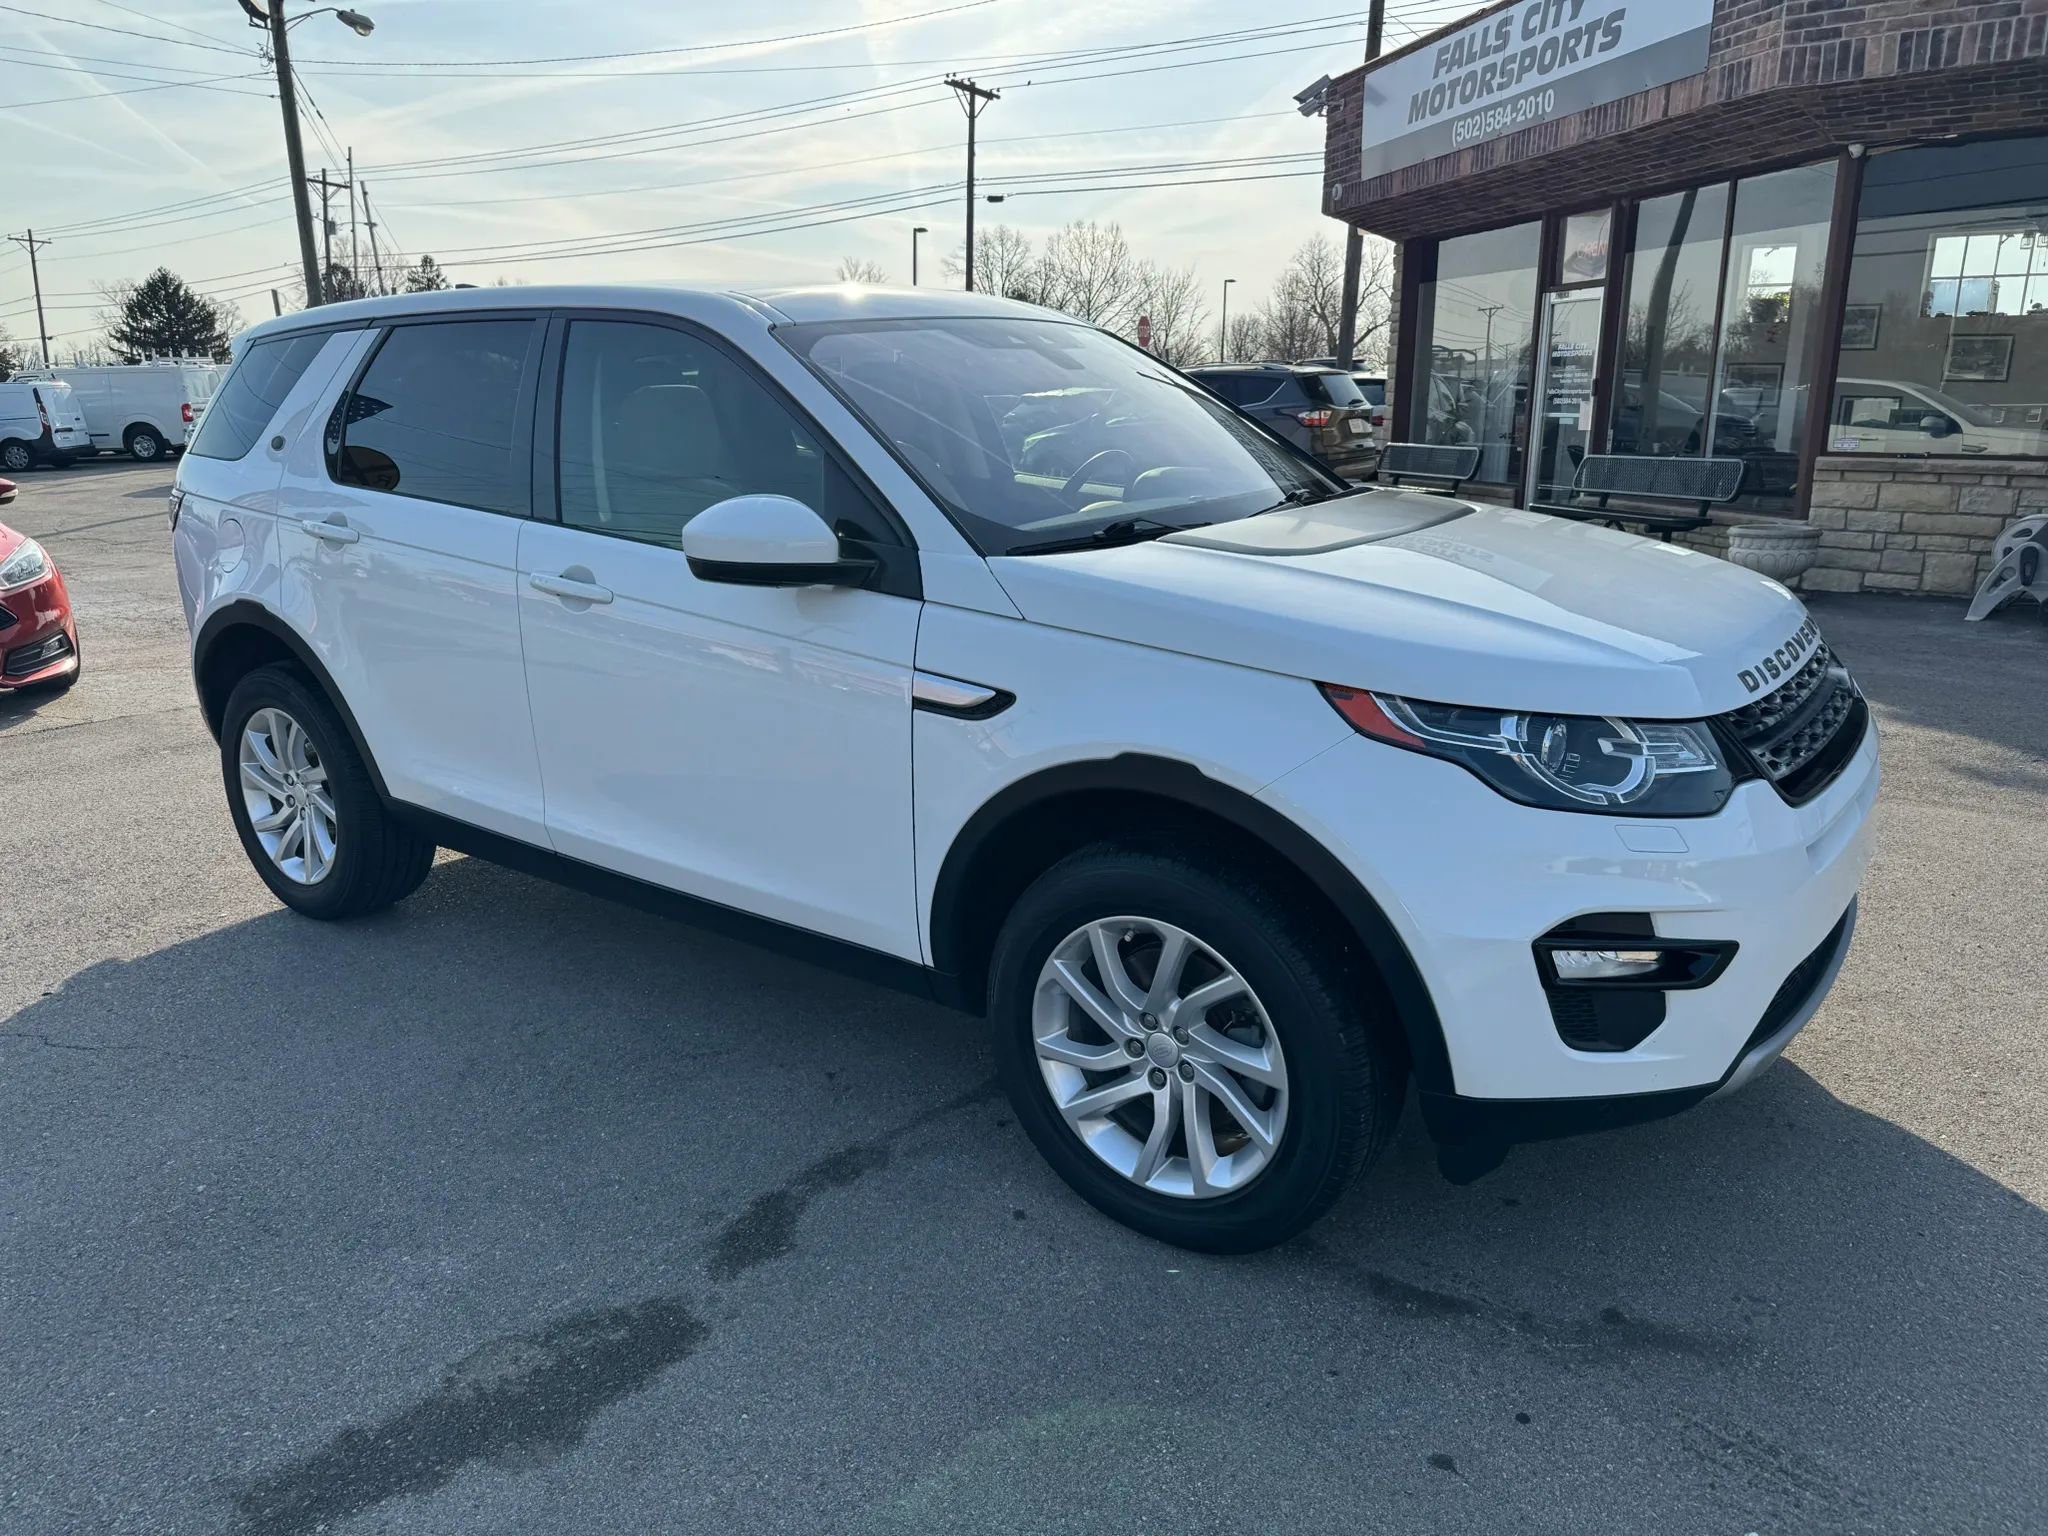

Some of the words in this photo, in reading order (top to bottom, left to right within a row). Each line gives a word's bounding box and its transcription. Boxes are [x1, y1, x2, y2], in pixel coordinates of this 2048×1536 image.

[1408, 8, 1627, 125] MOTORSPORTS
[1433, 15, 1514, 79] FALLS
[1521, 0, 1584, 41] CITY
[1452, 89, 1554, 147] (502)584-2010
